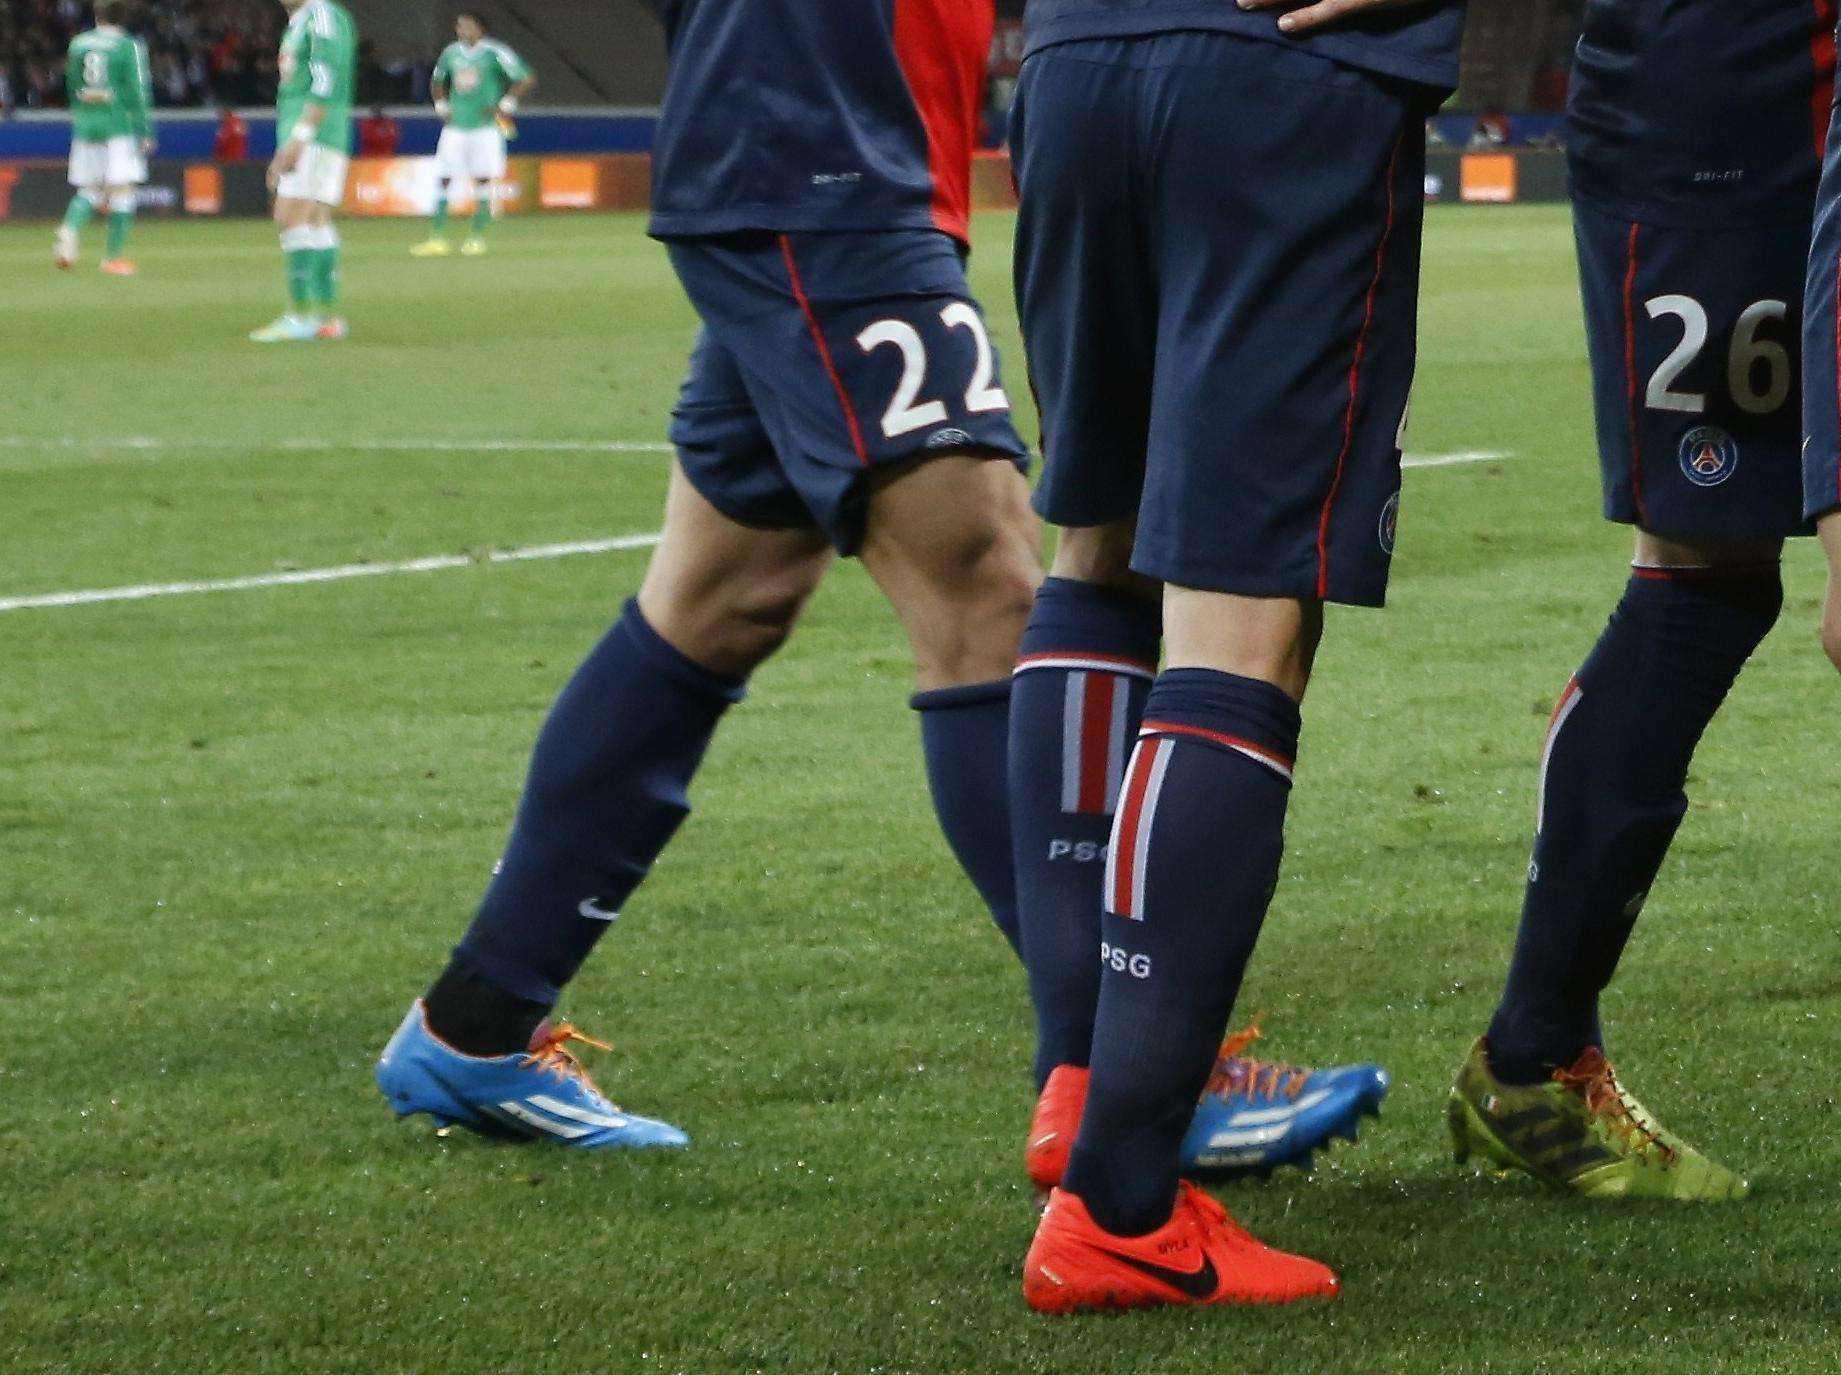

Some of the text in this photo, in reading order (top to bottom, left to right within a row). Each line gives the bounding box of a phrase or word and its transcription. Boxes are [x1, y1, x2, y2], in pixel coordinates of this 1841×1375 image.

[856, 301, 1011, 439] 22
[1644, 294, 1790, 414] 26
[1101, 941, 1151, 979] PSG
